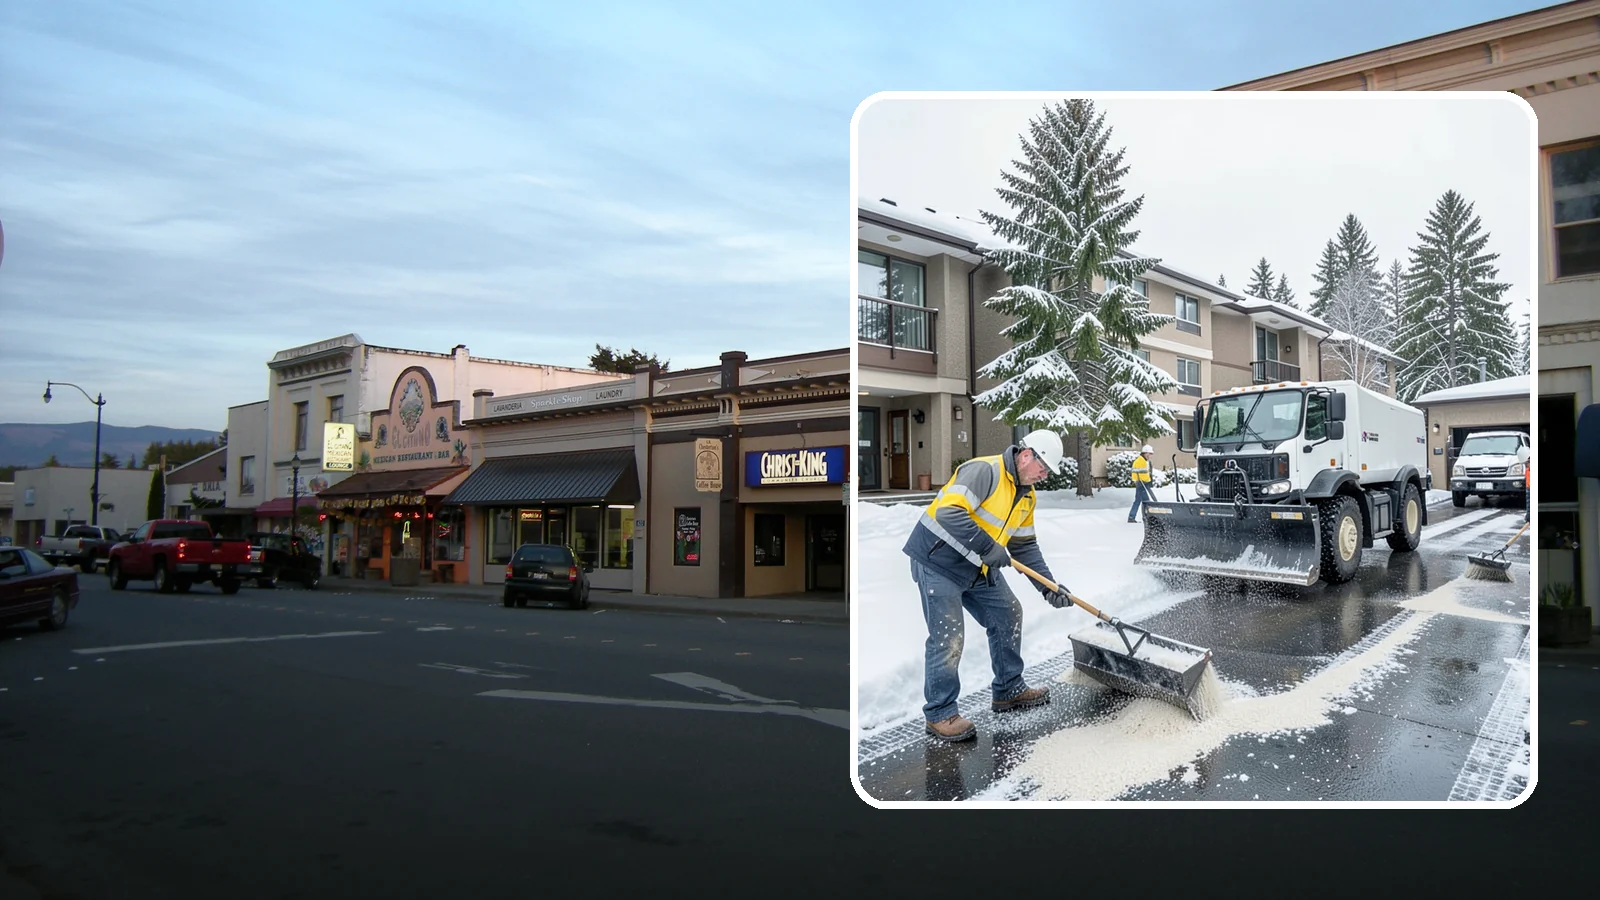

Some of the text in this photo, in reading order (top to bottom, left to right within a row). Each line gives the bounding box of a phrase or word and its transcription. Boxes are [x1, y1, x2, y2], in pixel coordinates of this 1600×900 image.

[595, 389, 623, 400] LAUNDRY
[493, 402, 523, 412] LAVANDERIA
[530, 394, 582, 409] Sparkle Shop
[398, 452, 433, 462] RESTAURANT
[438, 450, 449, 458] BAR
[760, 450, 827, 478] CHRIST KING
